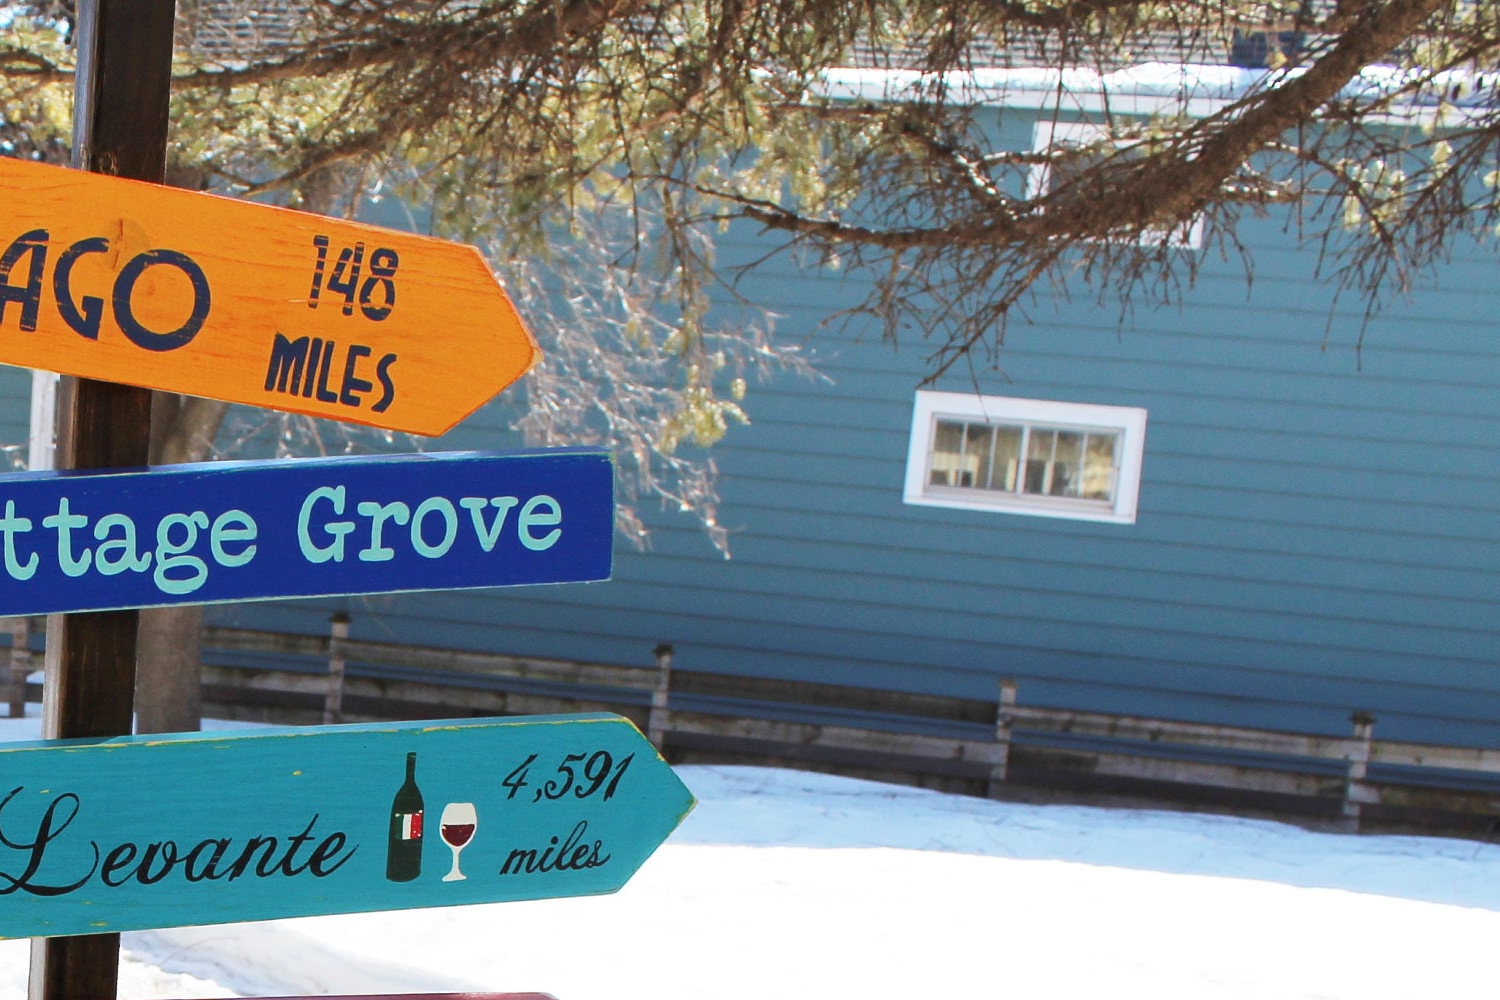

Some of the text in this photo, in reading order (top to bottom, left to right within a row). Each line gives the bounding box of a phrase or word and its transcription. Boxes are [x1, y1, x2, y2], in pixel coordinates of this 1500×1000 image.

[307, 234, 399, 321] 148
[265, 333, 397, 413] MILES
[299, 485, 563, 564] Grove
[501, 751, 636, 804] 4,591
[500, 820, 612, 877] miles
